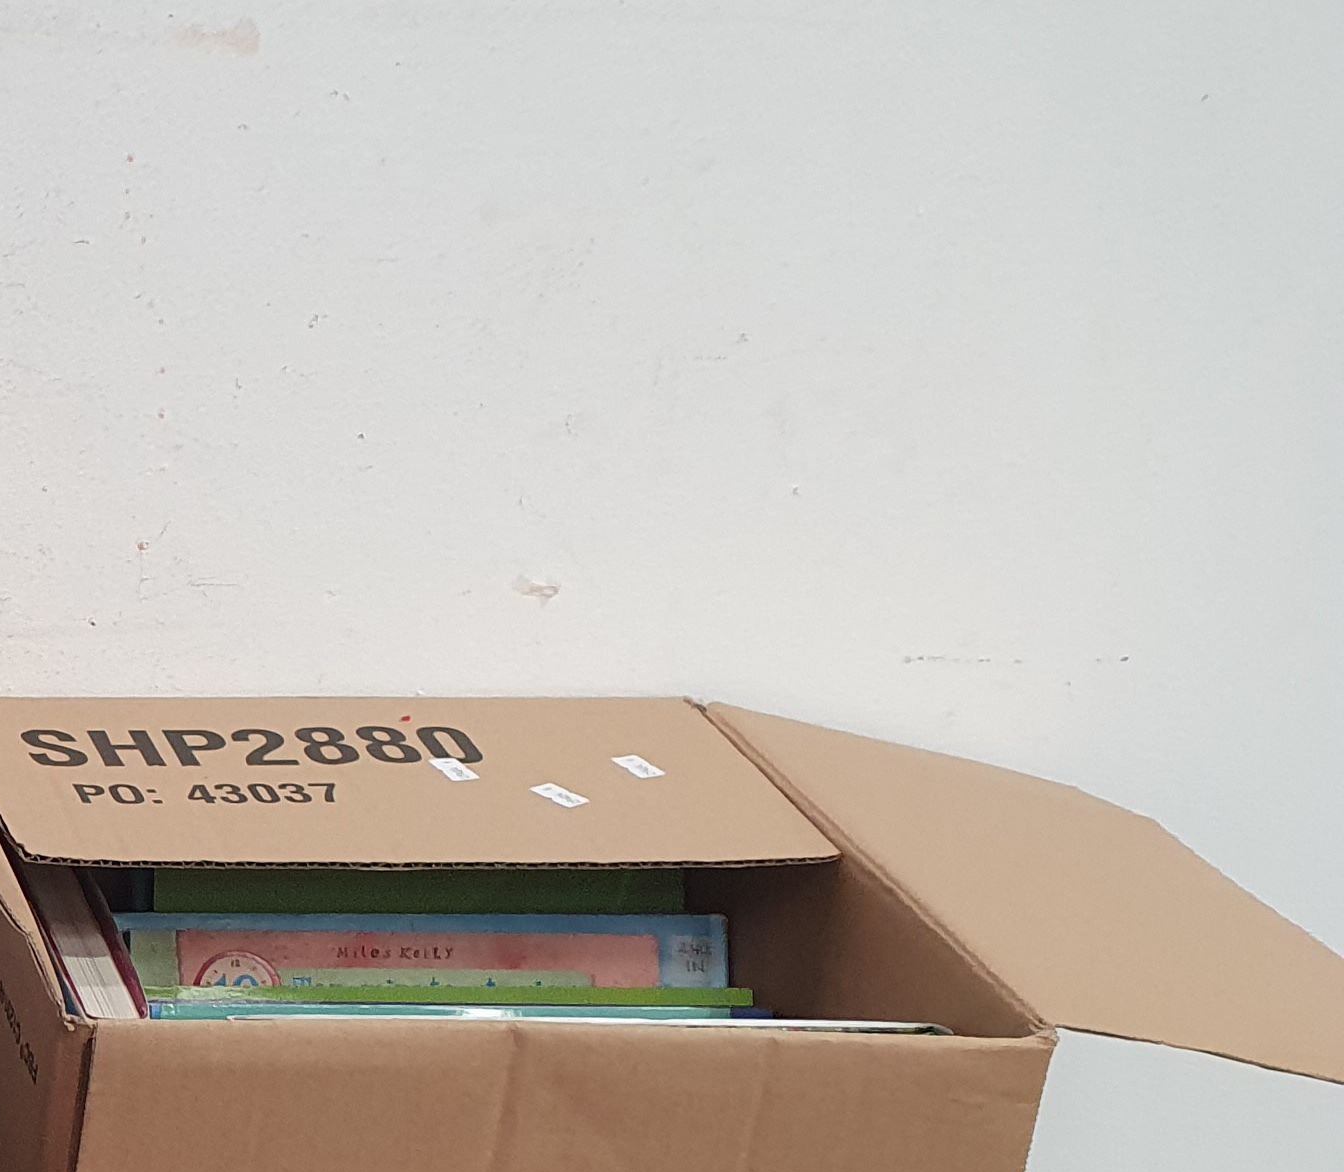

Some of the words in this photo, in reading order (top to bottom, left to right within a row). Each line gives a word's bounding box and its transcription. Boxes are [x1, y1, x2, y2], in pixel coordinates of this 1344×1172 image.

[20, 725, 484, 768] SHP2880
[72, 783, 163, 805] PO:
[188, 782, 337, 804] 43037
